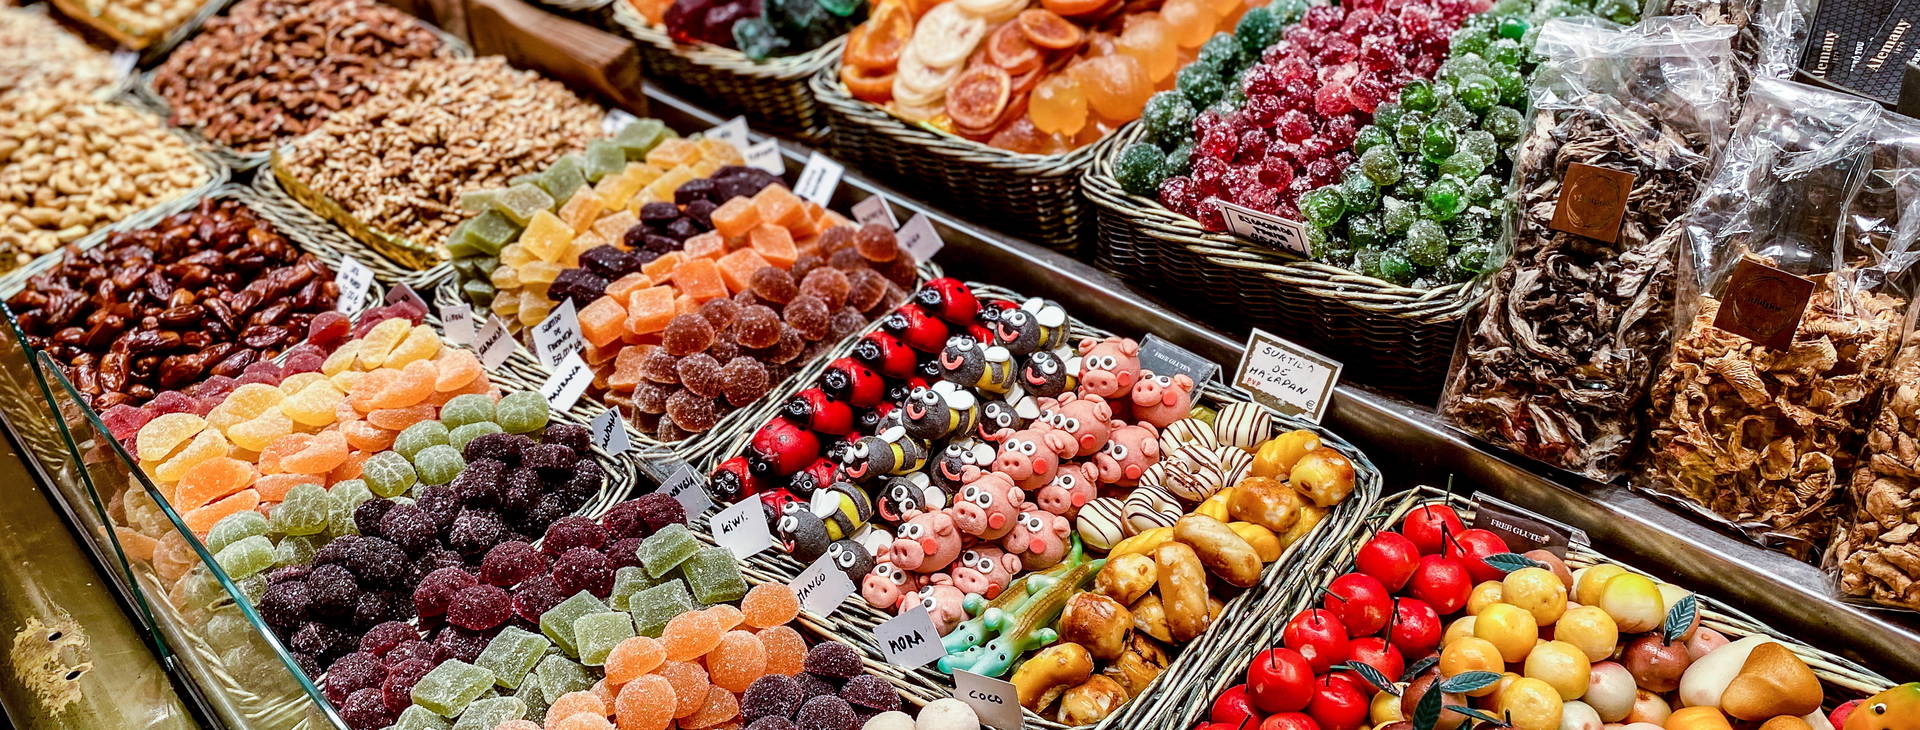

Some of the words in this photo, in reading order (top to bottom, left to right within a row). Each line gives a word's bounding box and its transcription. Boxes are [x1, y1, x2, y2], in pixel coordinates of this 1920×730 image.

[1866, 18, 1911, 72] Alemany
[1153, 351, 1170, 362] FREE
[1169, 358, 1191, 373] GLUTEN
[1272, 364, 1291, 376] DE
[1490, 518, 1512, 532] FREE
[1512, 526, 1542, 543] GLUTE
[797, 573, 826, 604] MANGO
[888, 629, 926, 655] MORA
[968, 690, 1003, 705] COCO
